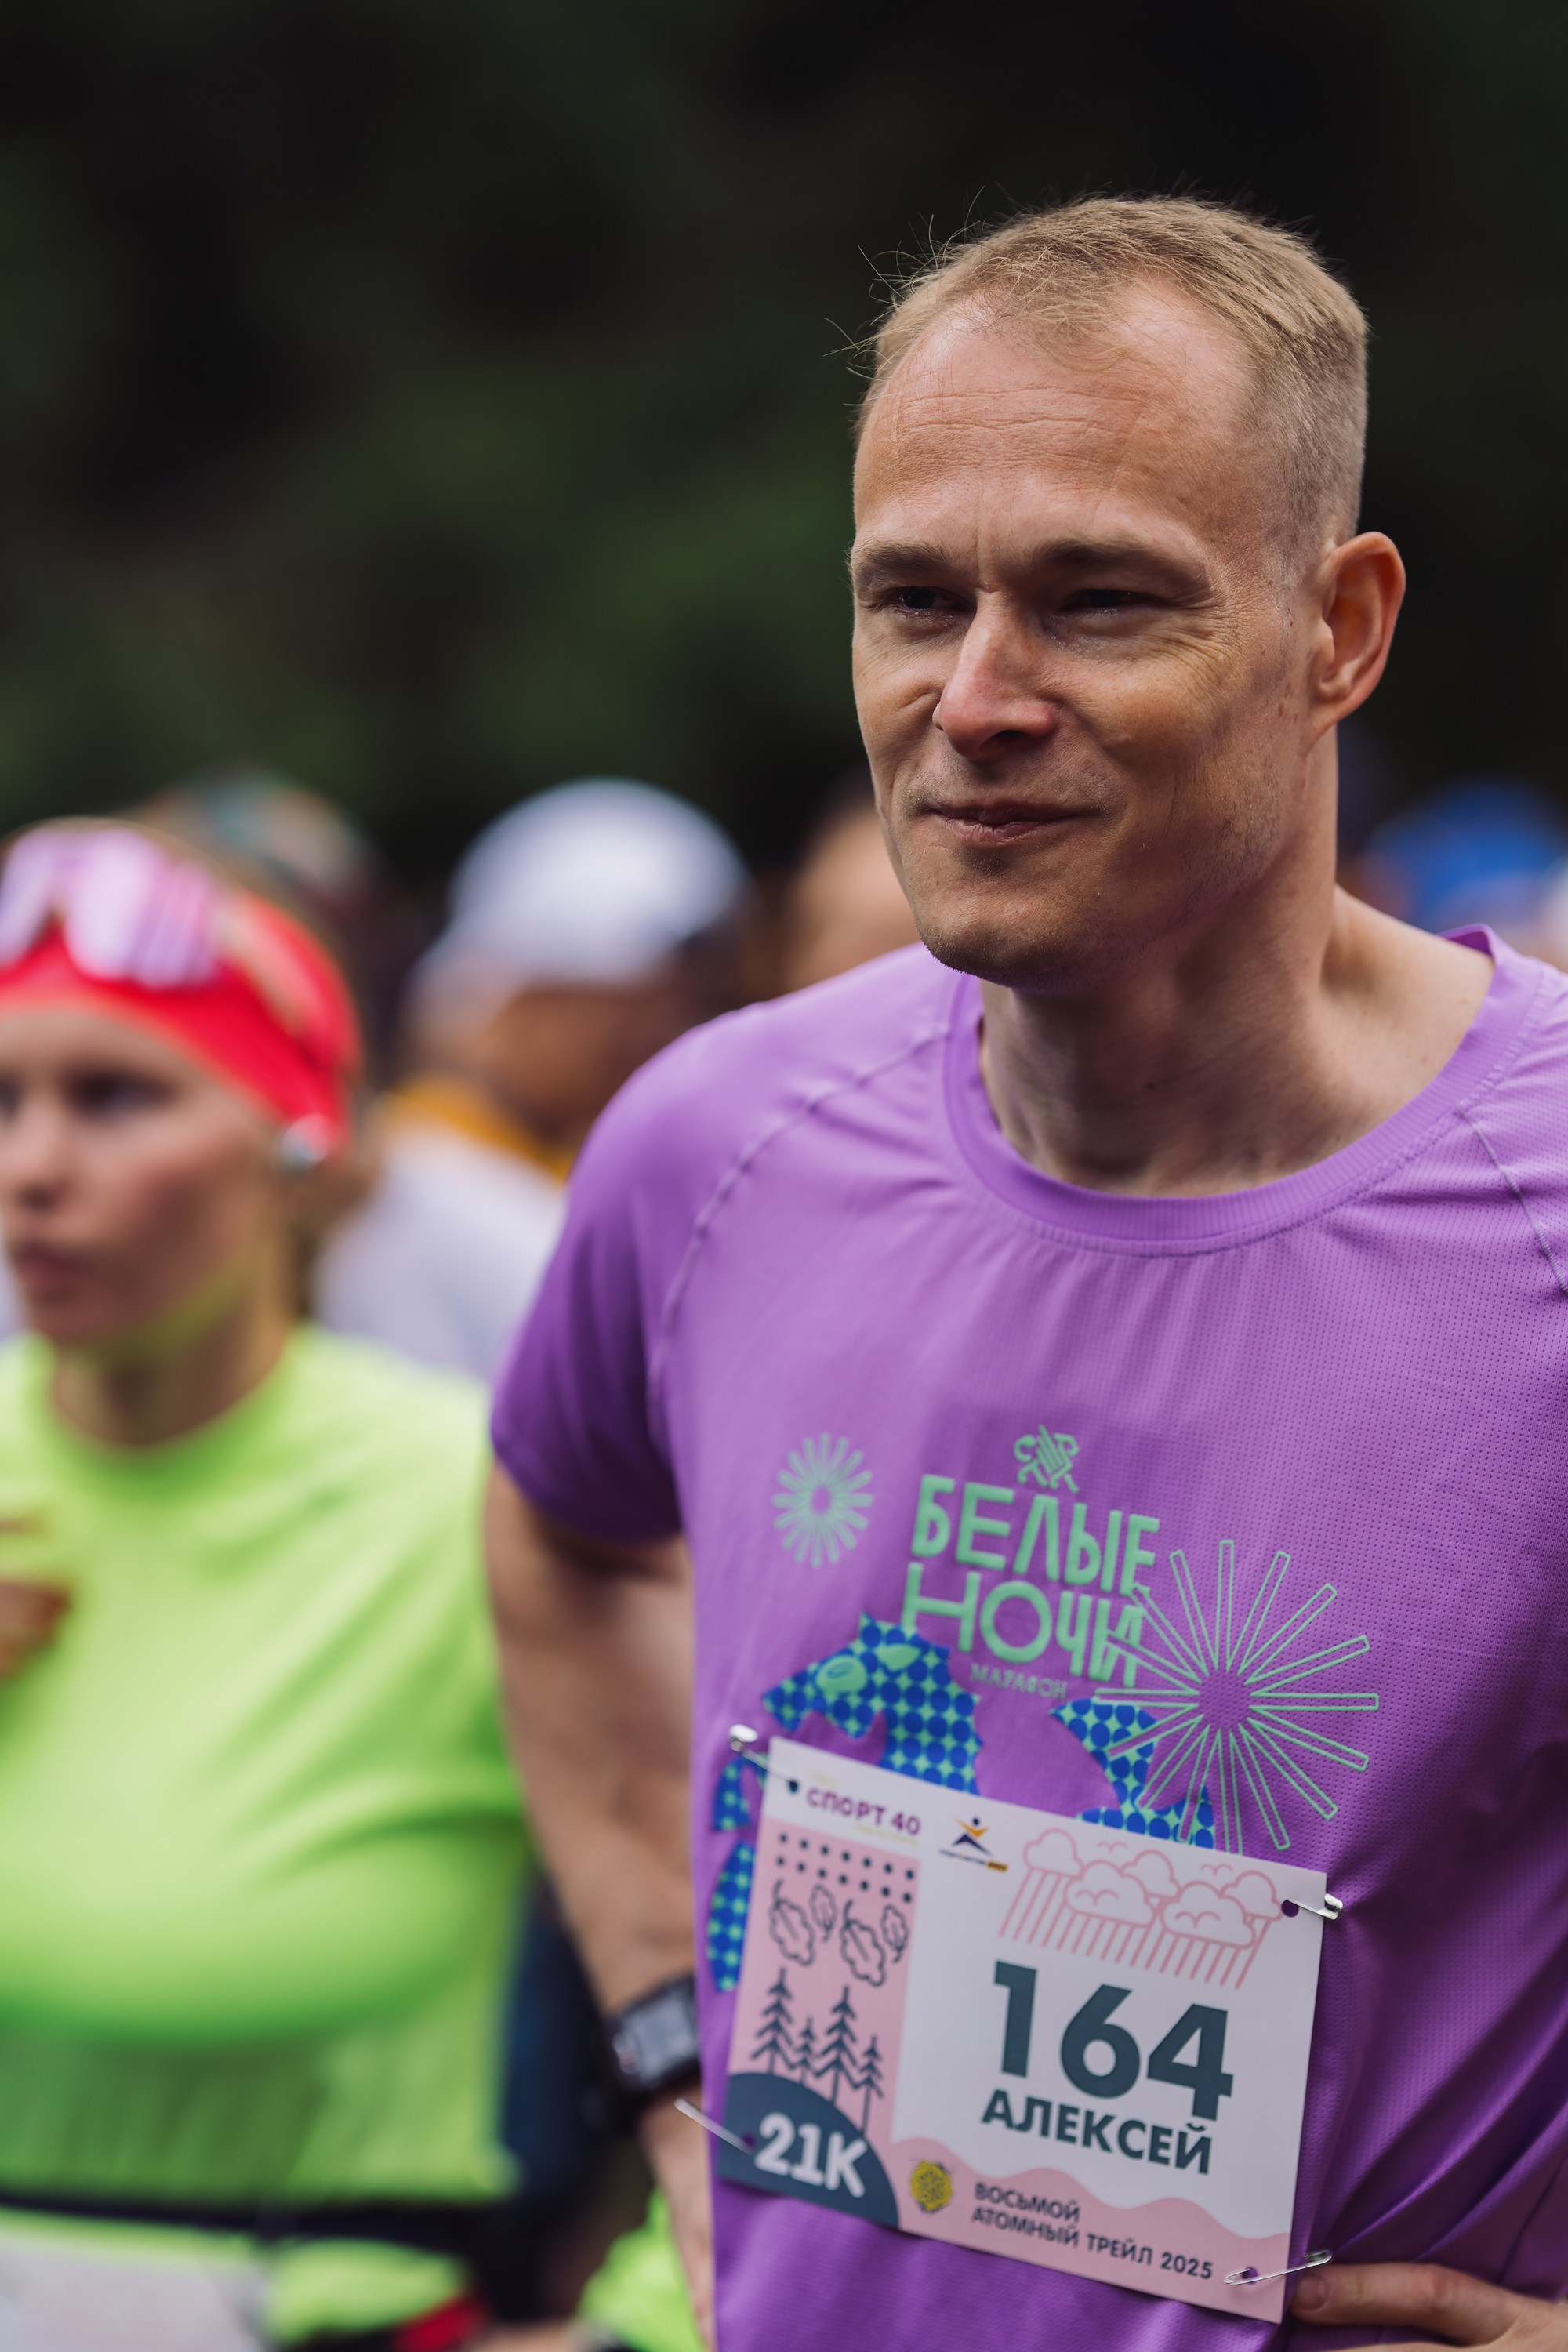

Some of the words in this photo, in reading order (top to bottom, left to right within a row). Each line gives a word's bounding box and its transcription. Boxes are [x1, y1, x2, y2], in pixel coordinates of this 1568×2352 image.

[912, 1474, 1160, 1596] БЕЛЫЕ
[902, 1562, 1144, 1687] НОЧИ
[807, 1788, 885, 1826] СПОРТ
[891, 1811, 920, 1836] 40
[993, 1959, 1233, 2122] 164
[981, 2087, 1212, 2176] АЛЕКСЕЙ
[971, 2206, 1079, 2249] АТОМНЫЙ
[1086, 2233, 1152, 2266] ТРЕЙЛ
[1160, 2251, 1213, 2280] 2025
[975, 2183, 1080, 2223] ВОСЬМОЙ
